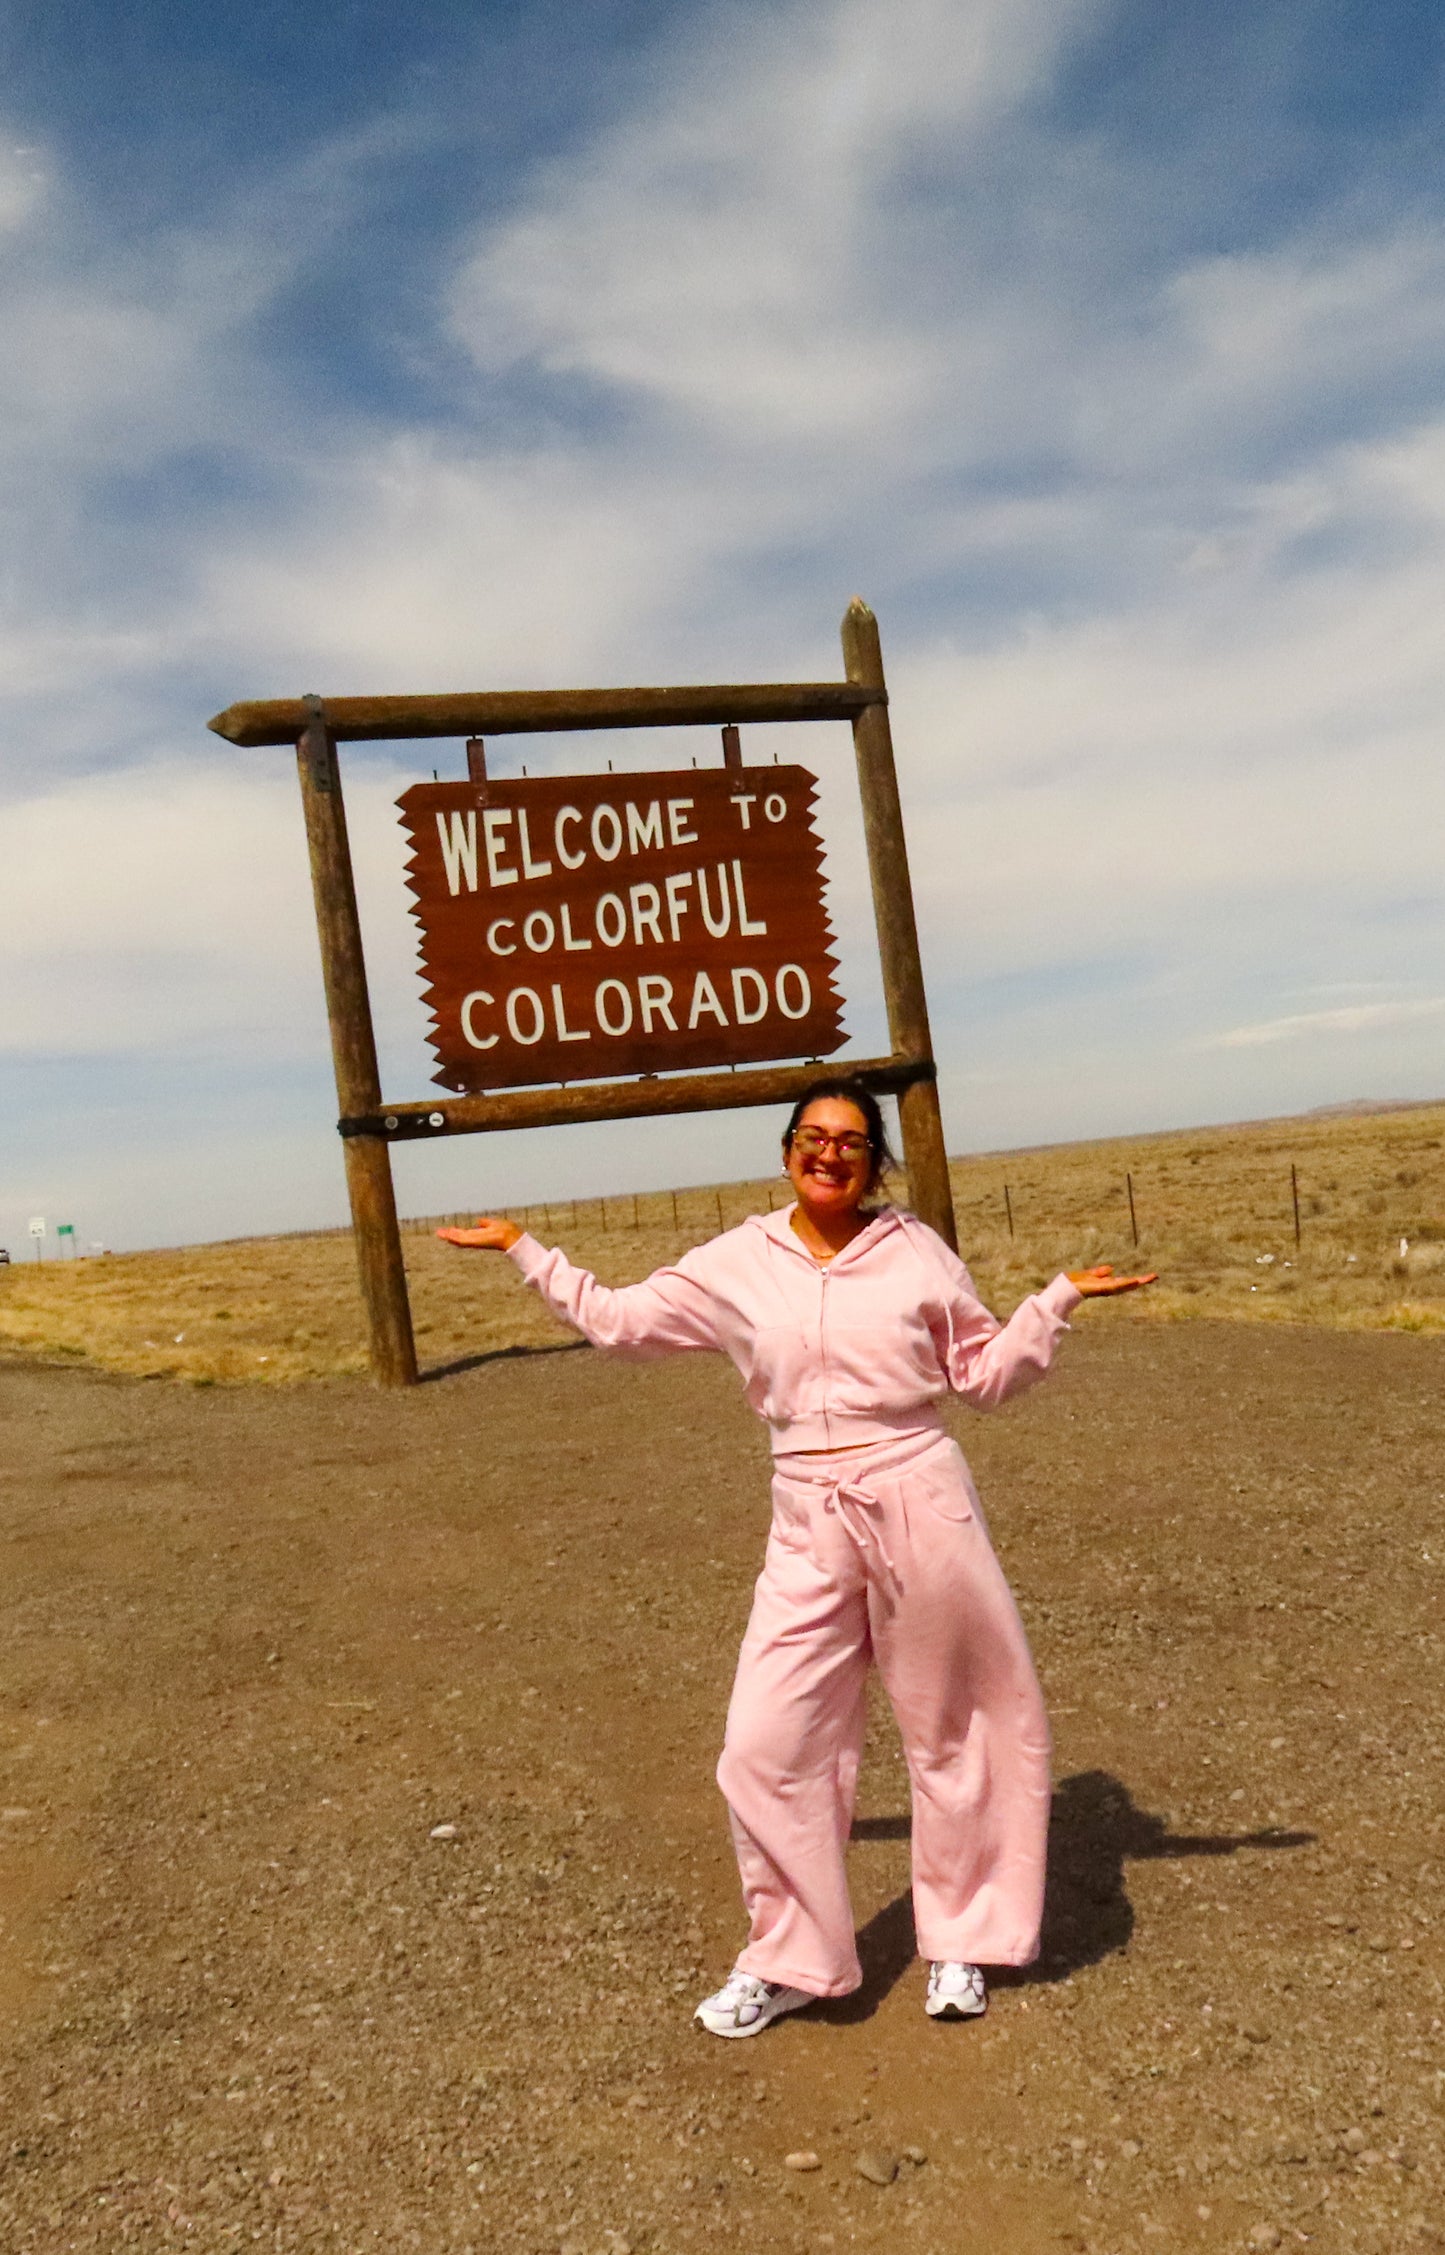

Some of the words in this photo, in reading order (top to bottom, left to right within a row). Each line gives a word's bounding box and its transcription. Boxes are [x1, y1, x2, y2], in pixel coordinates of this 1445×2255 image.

[435, 798, 699, 897] WELCOME
[730, 793, 788, 830] TO
[486, 858, 768, 957] COLORFUL
[460, 963, 812, 1050] COLORADO
